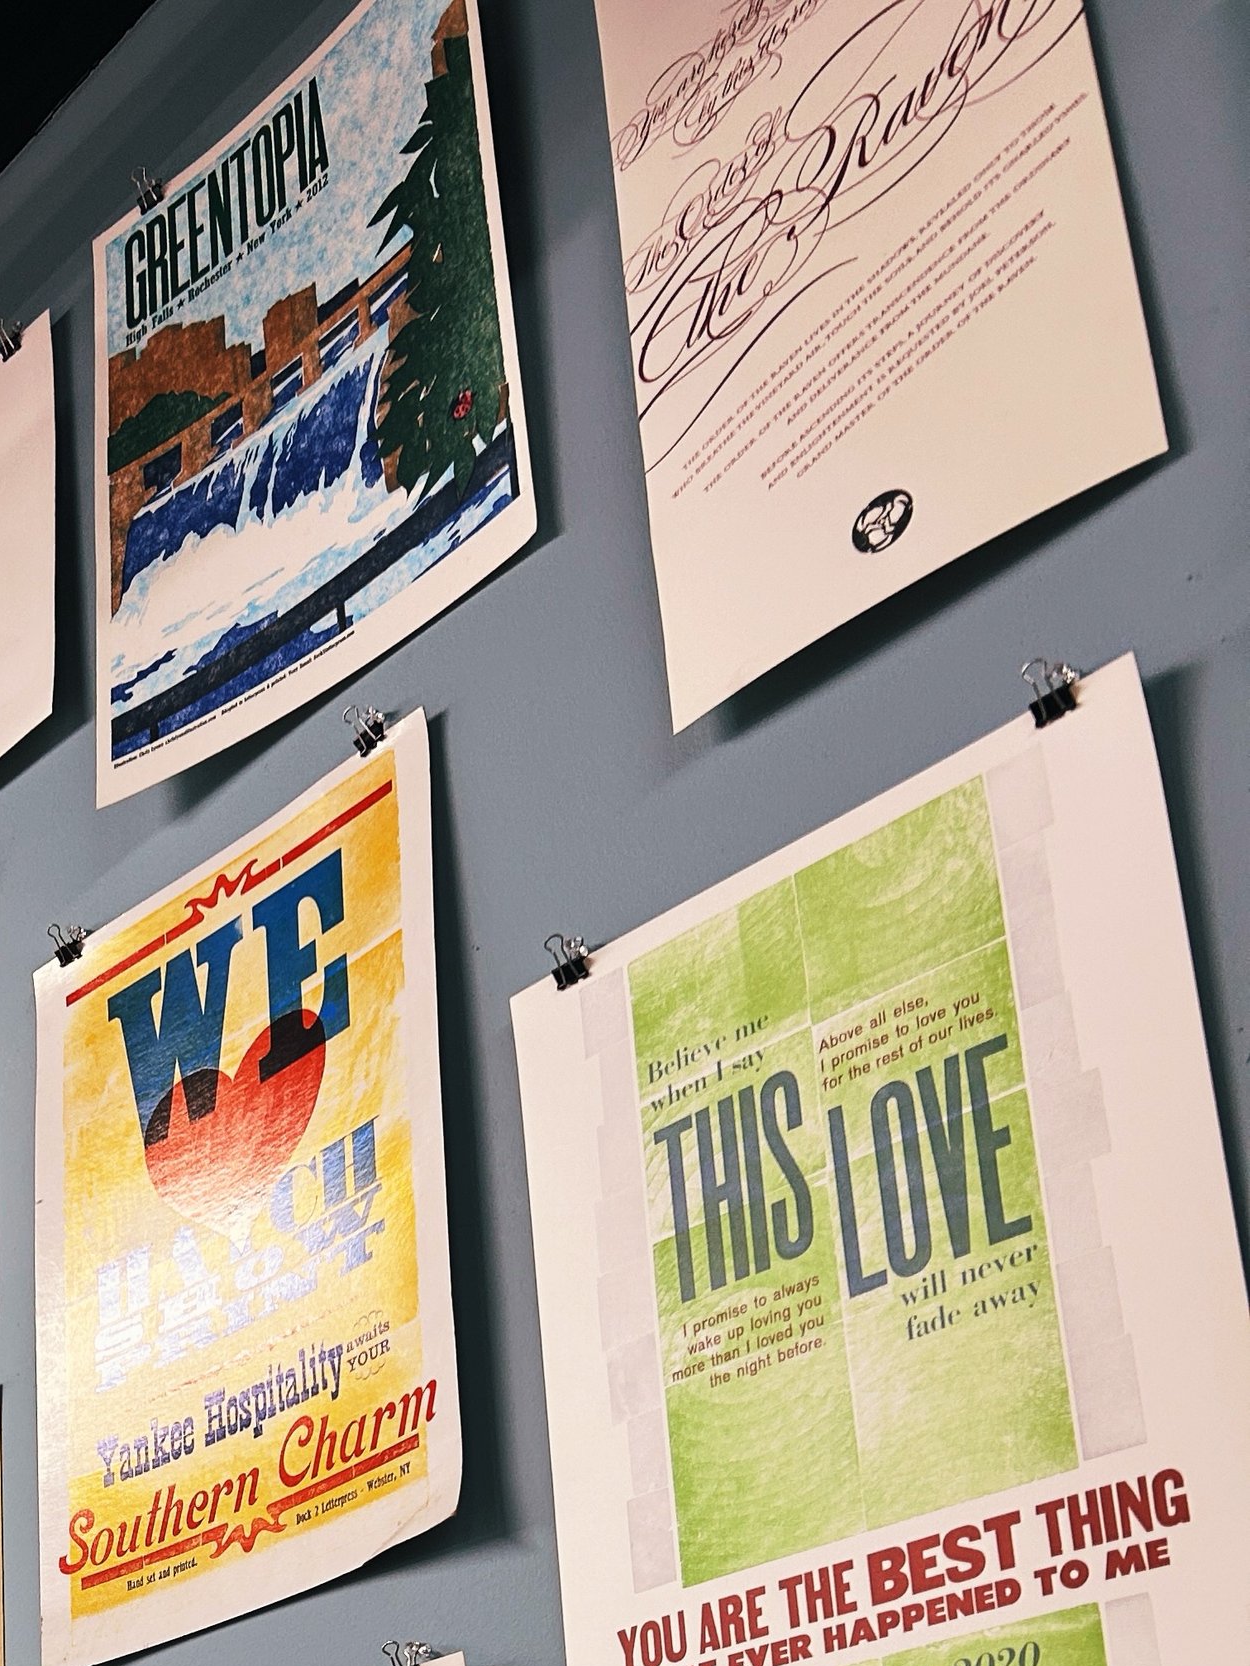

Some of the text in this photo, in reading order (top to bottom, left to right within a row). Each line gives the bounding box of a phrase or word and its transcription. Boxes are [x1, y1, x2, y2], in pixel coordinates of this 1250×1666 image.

[124, 76, 329, 329] GREENTOPIA
[126, 174, 329, 347] High Falls Rochester New York 2012
[107, 847, 350, 1149] WE
[819, 996, 929, 1054] Above all else,
[648, 1013, 770, 1085] Believe me
[650, 1046, 767, 1113] when I say
[653, 1033, 1033, 1302] THIS LOVE
[901, 1244, 1040, 1307] will never
[905, 1279, 1041, 1341] fade away
[346, 1319, 390, 1354] awaits
[347, 1338, 391, 1372] YOUR
[96, 1340, 345, 1488] Yankee Hospitality
[59, 1377, 438, 1575] Southern Charm
[296, 1509, 312, 1525] Dock
[321, 1488, 358, 1514] Letterpress
[399, 1462, 411, 1478] NY
[699, 1585, 769, 1650] ARE
[779, 1560, 859, 1630] THE
[866, 1510, 1022, 1607] BEST
[1035, 1467, 1191, 1557] THING
[823, 1577, 1022, 1654] HAPPENED
[1034, 1559, 1089, 1596] TO
[1105, 1537, 1171, 1580] ME
